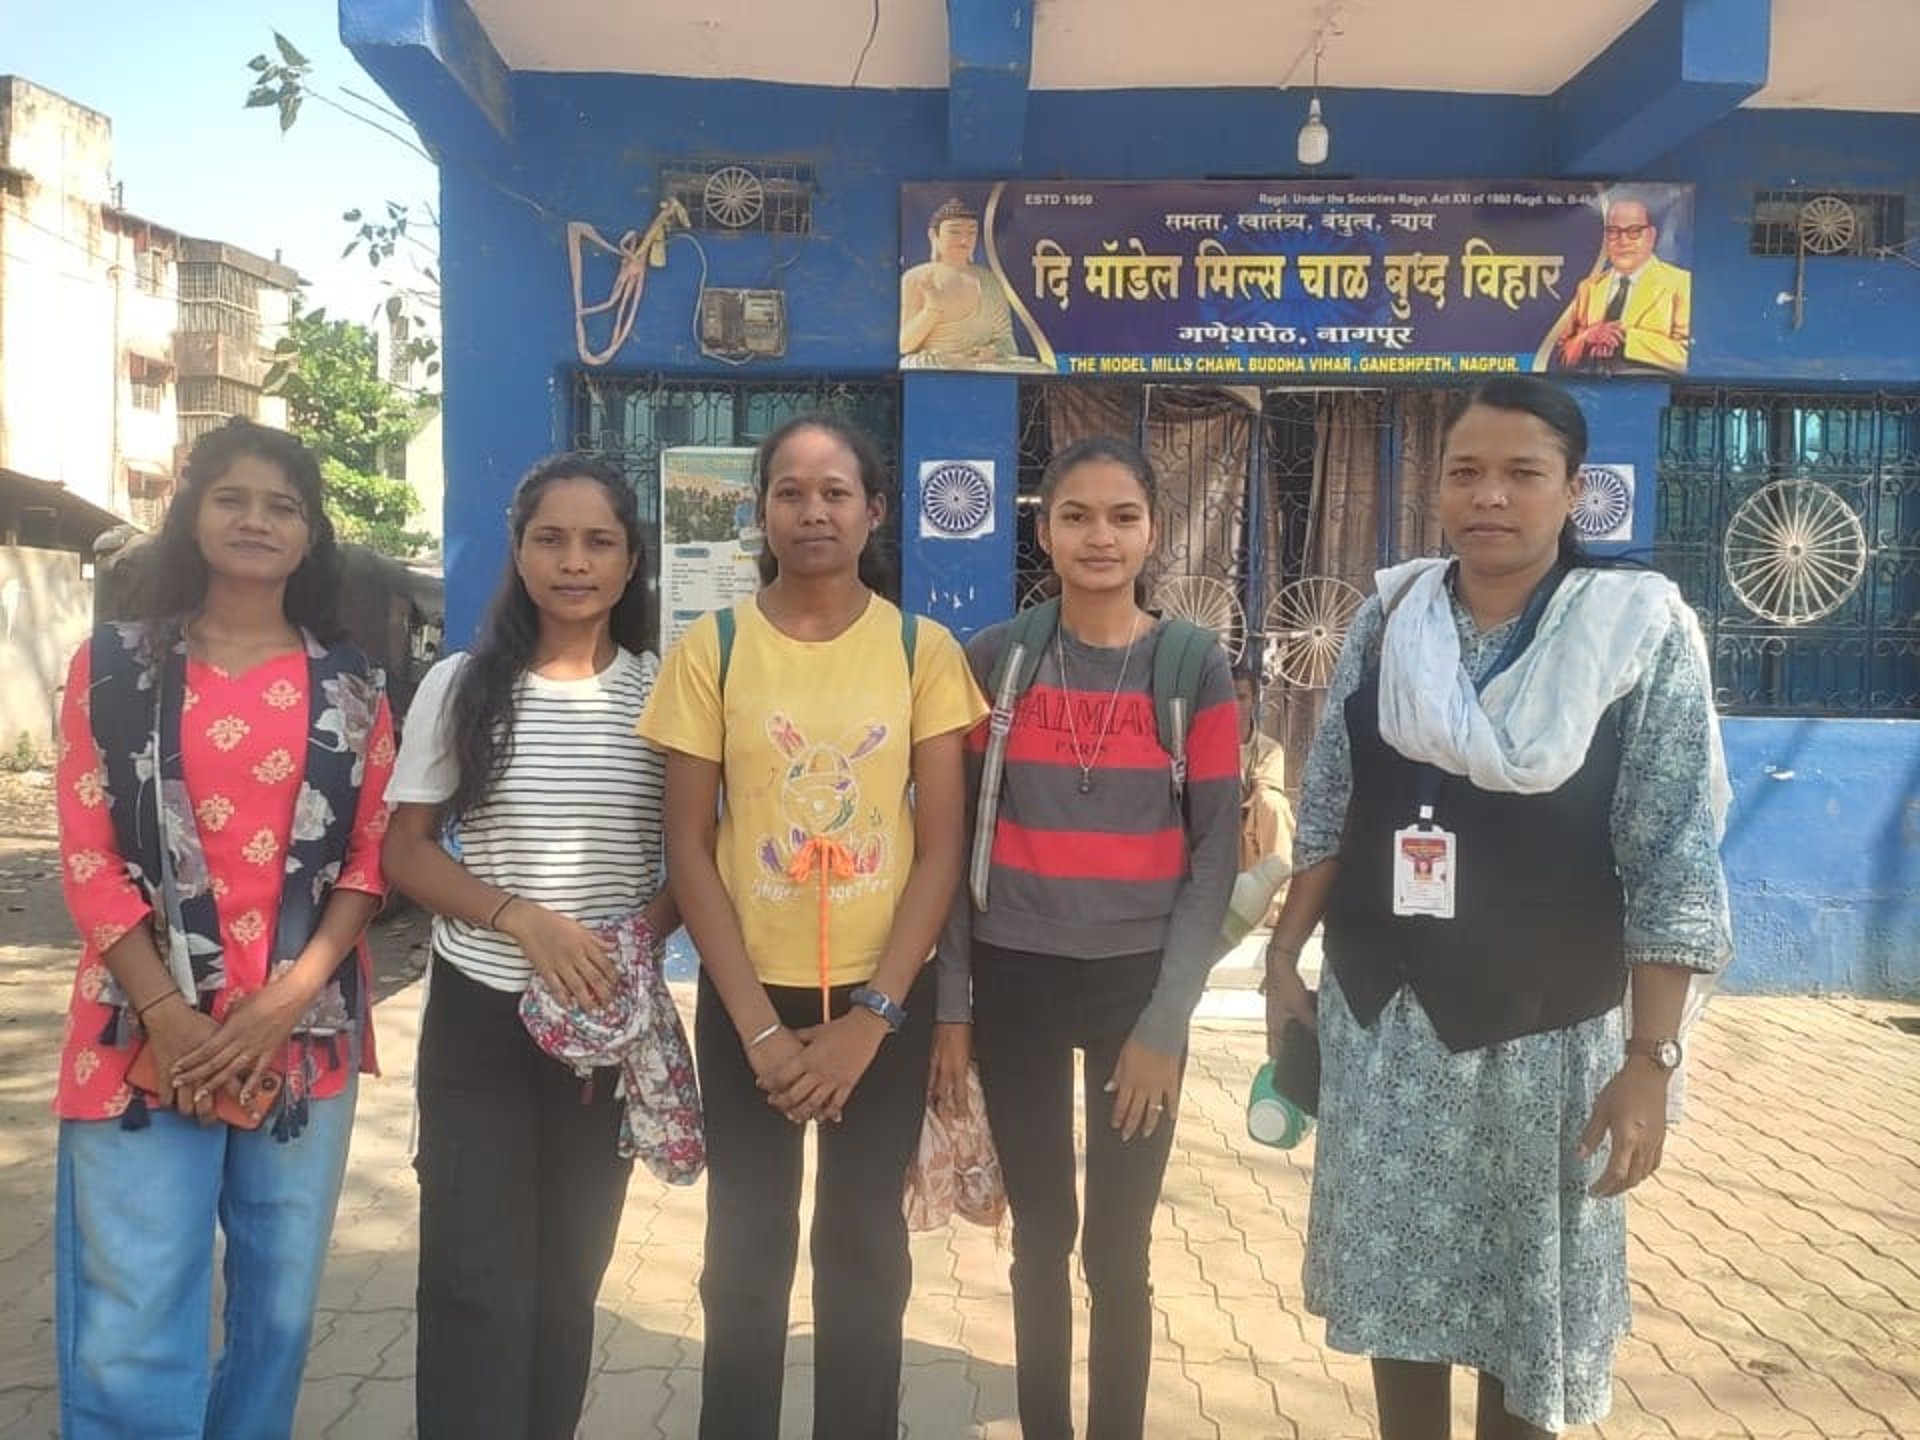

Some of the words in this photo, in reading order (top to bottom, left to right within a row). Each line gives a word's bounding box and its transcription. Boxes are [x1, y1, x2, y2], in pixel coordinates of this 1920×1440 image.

[1024, 193, 1060, 205] ESTD
[1390, 212, 1438, 232] न्याय
[1032, 239, 1072, 311] दि
[1083, 237, 1183, 301] मॉडेल
[1194, 238, 1287, 301] मिल्स
[1297, 255, 1372, 300] चाळ
[1461, 238, 1565, 311] विहार
[1316, 326, 1414, 350] नागपूर
[1069, 356, 1097, 373] THE
[1099, 356, 1148, 373] MODEL
[1195, 356, 1245, 373] CHAWL
[1248, 356, 1306, 373] BUDDHA
